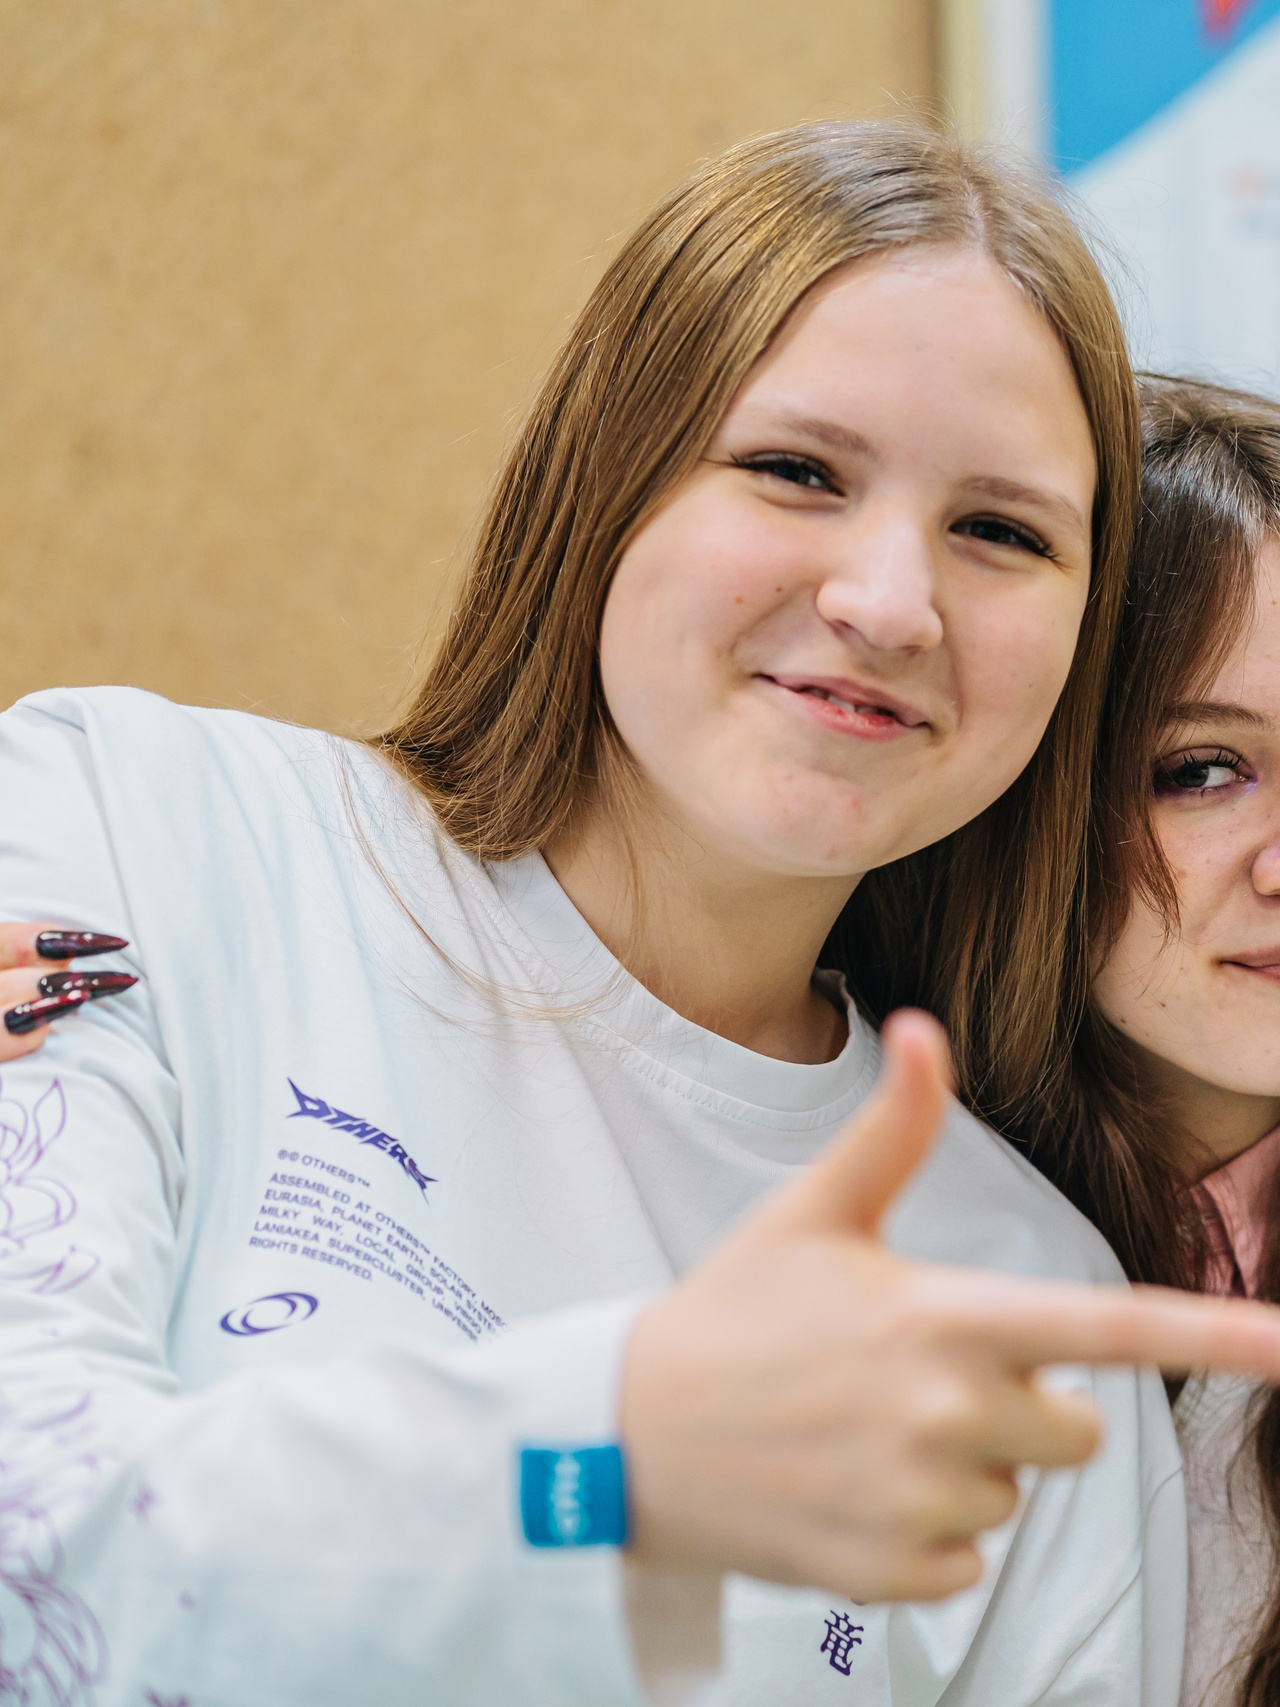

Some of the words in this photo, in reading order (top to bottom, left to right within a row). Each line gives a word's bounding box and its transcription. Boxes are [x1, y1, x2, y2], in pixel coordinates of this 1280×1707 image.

[269, 1173, 351, 1204] ASSEMBLED
[355, 1201, 371, 1214] AT
[249, 1236, 298, 1254] RIGHTS
[254, 1221, 319, 1242] LANIAKEA
[260, 1205, 301, 1219] MILKY
[356, 1233, 395, 1263] LOCAL
[455, 1301, 481, 1334] VIRGO
[332, 1206, 382, 1235] PLANET
[430, 1267, 462, 1299] SOLAR
